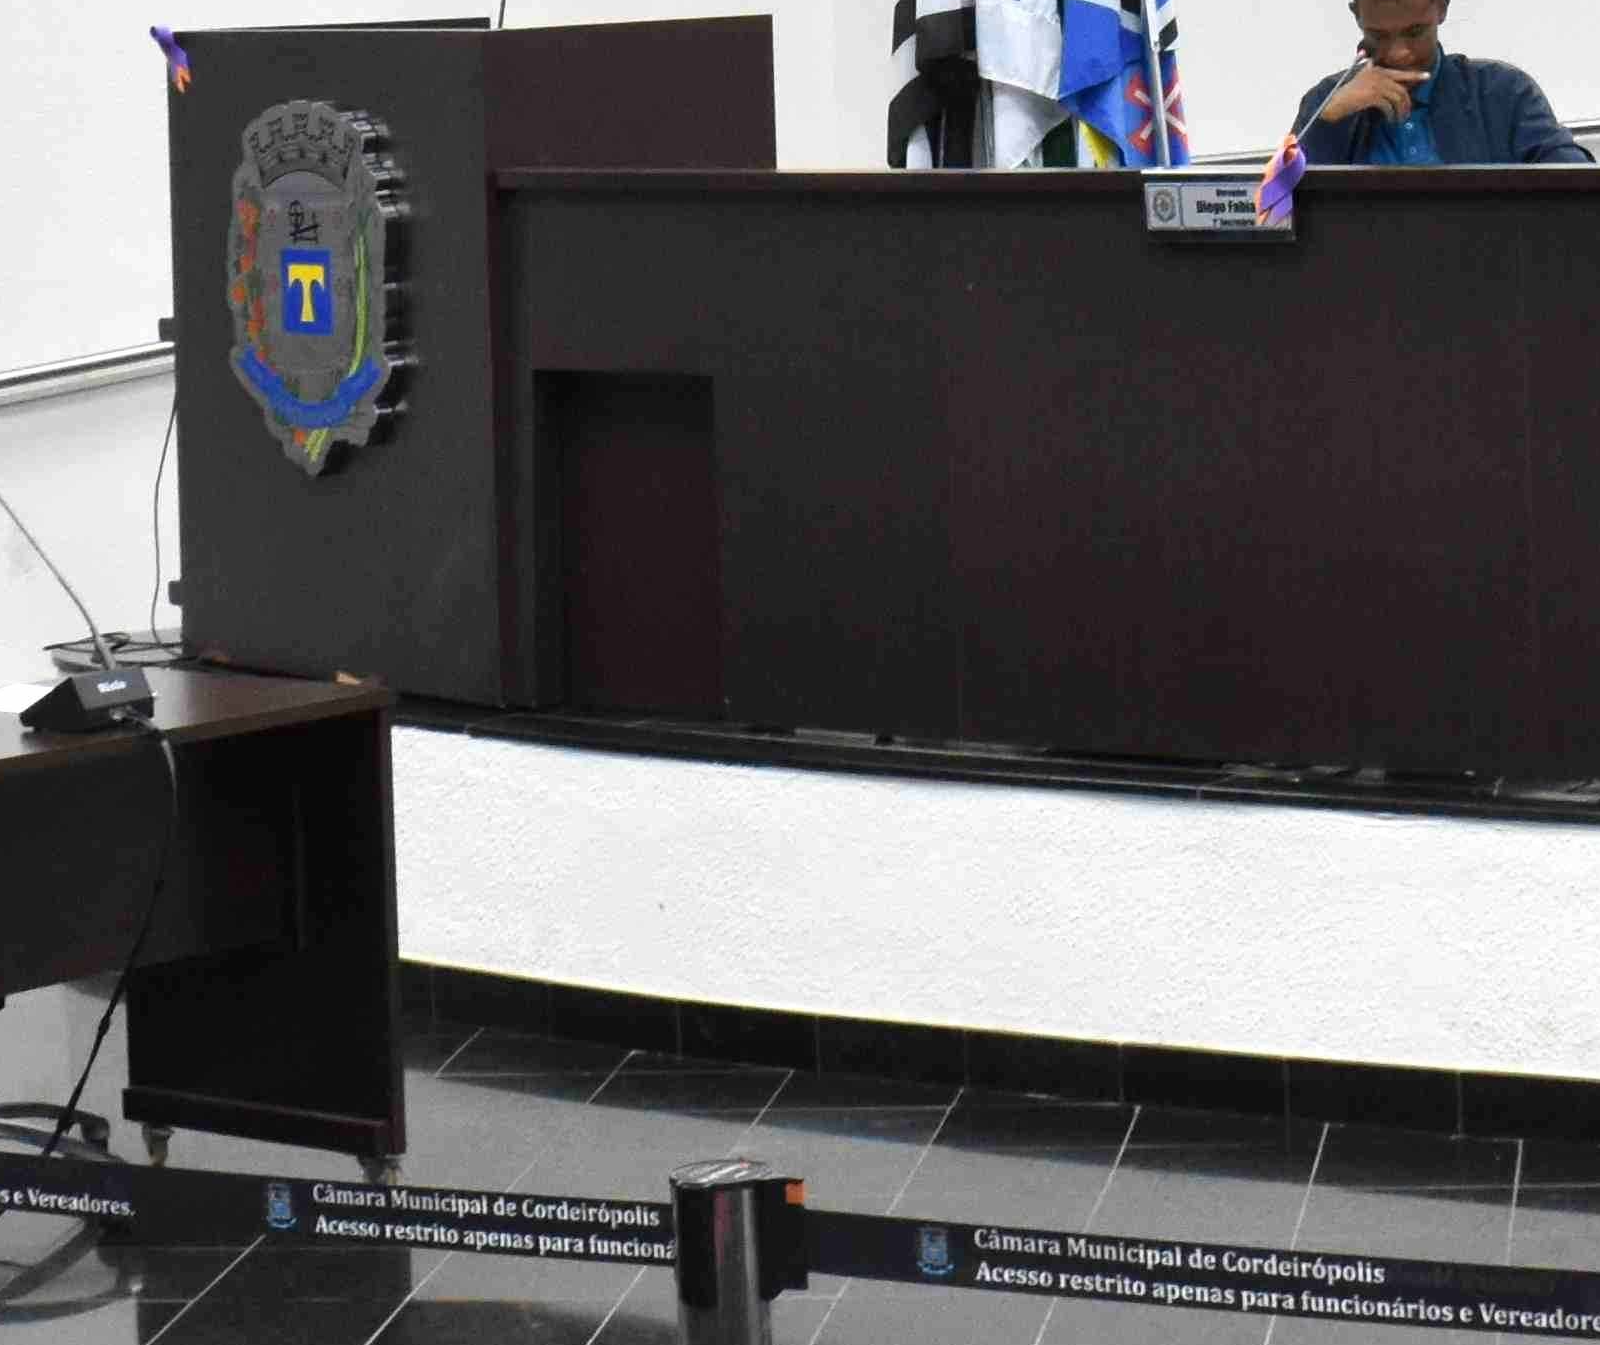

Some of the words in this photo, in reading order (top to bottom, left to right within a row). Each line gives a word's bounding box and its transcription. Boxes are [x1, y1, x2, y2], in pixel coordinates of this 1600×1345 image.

[13, 1191, 23, 1204] e
[28, 1189, 135, 1216] Vereadores.
[313, 1184, 385, 1206] Câmara
[391, 1190, 488, 1216] Municipal
[493, 1197, 516, 1216] de
[522, 1199, 660, 1226] Cordeirópolis
[316, 1215, 380, 1237] Acesso
[385, 1224, 459, 1243] restrito
[464, 1231, 534, 1249] apenas
[538, 1235, 584, 1253] para
[589, 1235, 675, 1259] funcioná
[974, 1229, 1060, 1255] Câmara
[1068, 1238, 1181, 1266] Municipal
[1188, 1248, 1216, 1270] de
[1222, 1251, 1384, 1283] Cordeirópolis
[976, 1262, 1053, 1286] Acesso
[1059, 1274, 1146, 1296] restrito
[1152, 1283, 1235, 1304] apenas
[1240, 1289, 1295, 1310] para
[1301, 1291, 1453, 1321] funcionários
[1460, 1307, 1472, 1322] e
